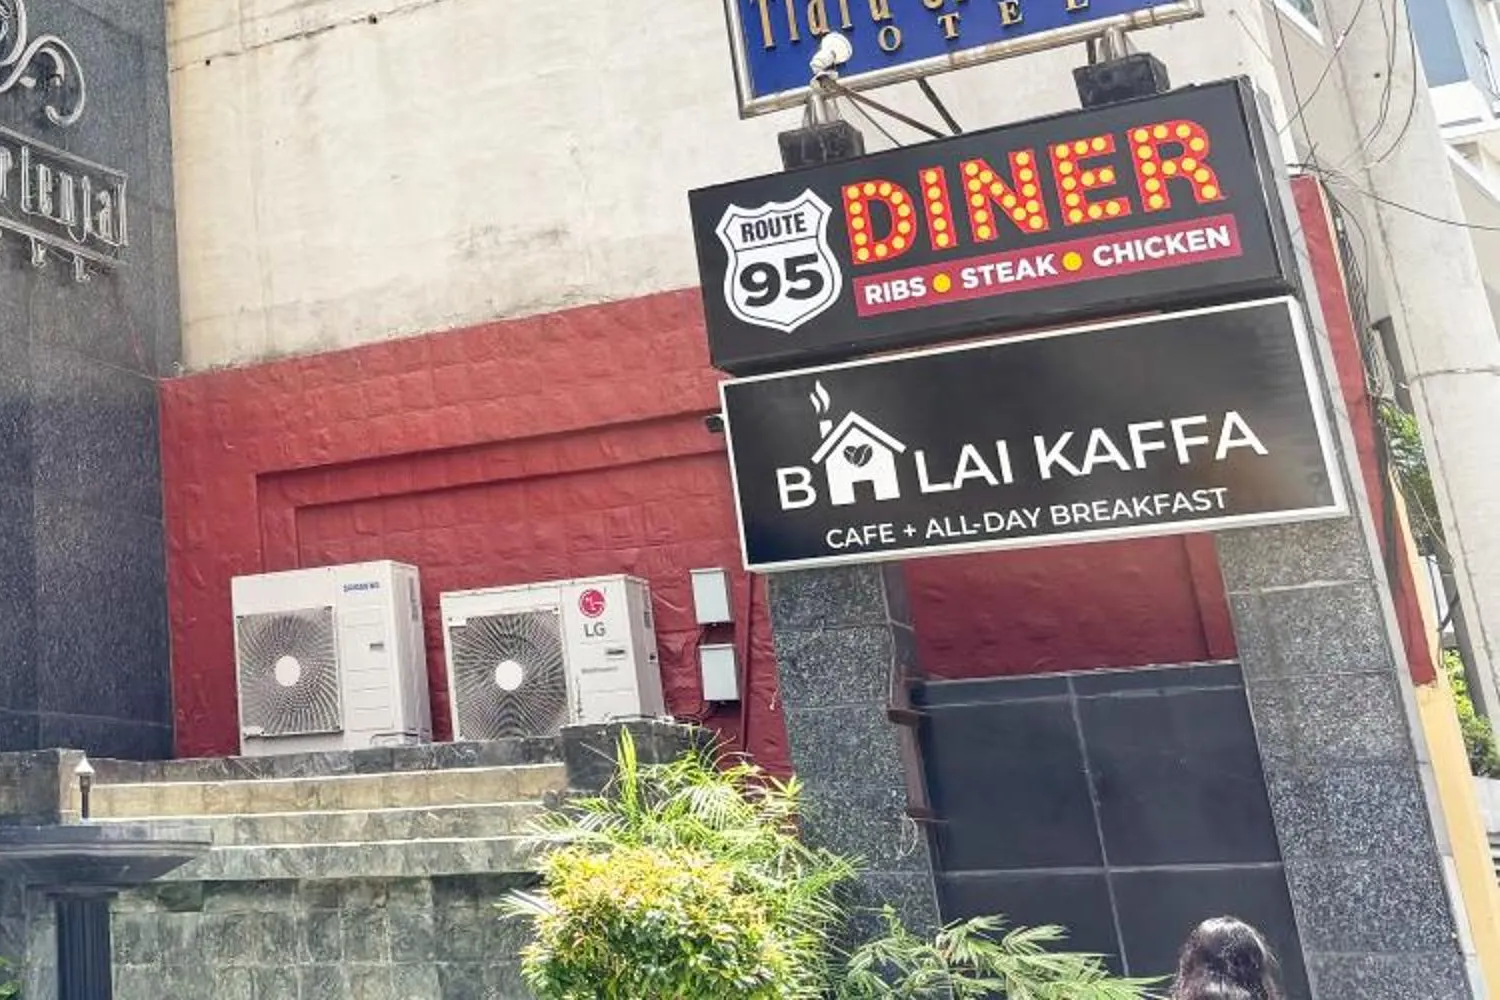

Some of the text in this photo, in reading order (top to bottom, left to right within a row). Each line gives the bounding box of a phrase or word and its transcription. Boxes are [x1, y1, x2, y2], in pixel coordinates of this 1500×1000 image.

[841, 118, 1227, 265] DINER
[741, 212, 807, 243] ROUTE
[739, 254, 825, 307] 95
[865, 225, 1232, 304] RIBS STEAK CHICKEN
[1033, 410, 1268, 480] KAFFA
[826, 522, 896, 550] CAFE
[925, 506, 1045, 538] ALL-DAY
[1051, 487, 1229, 526] BREAKFAST
[583, 621, 606, 638] LG
